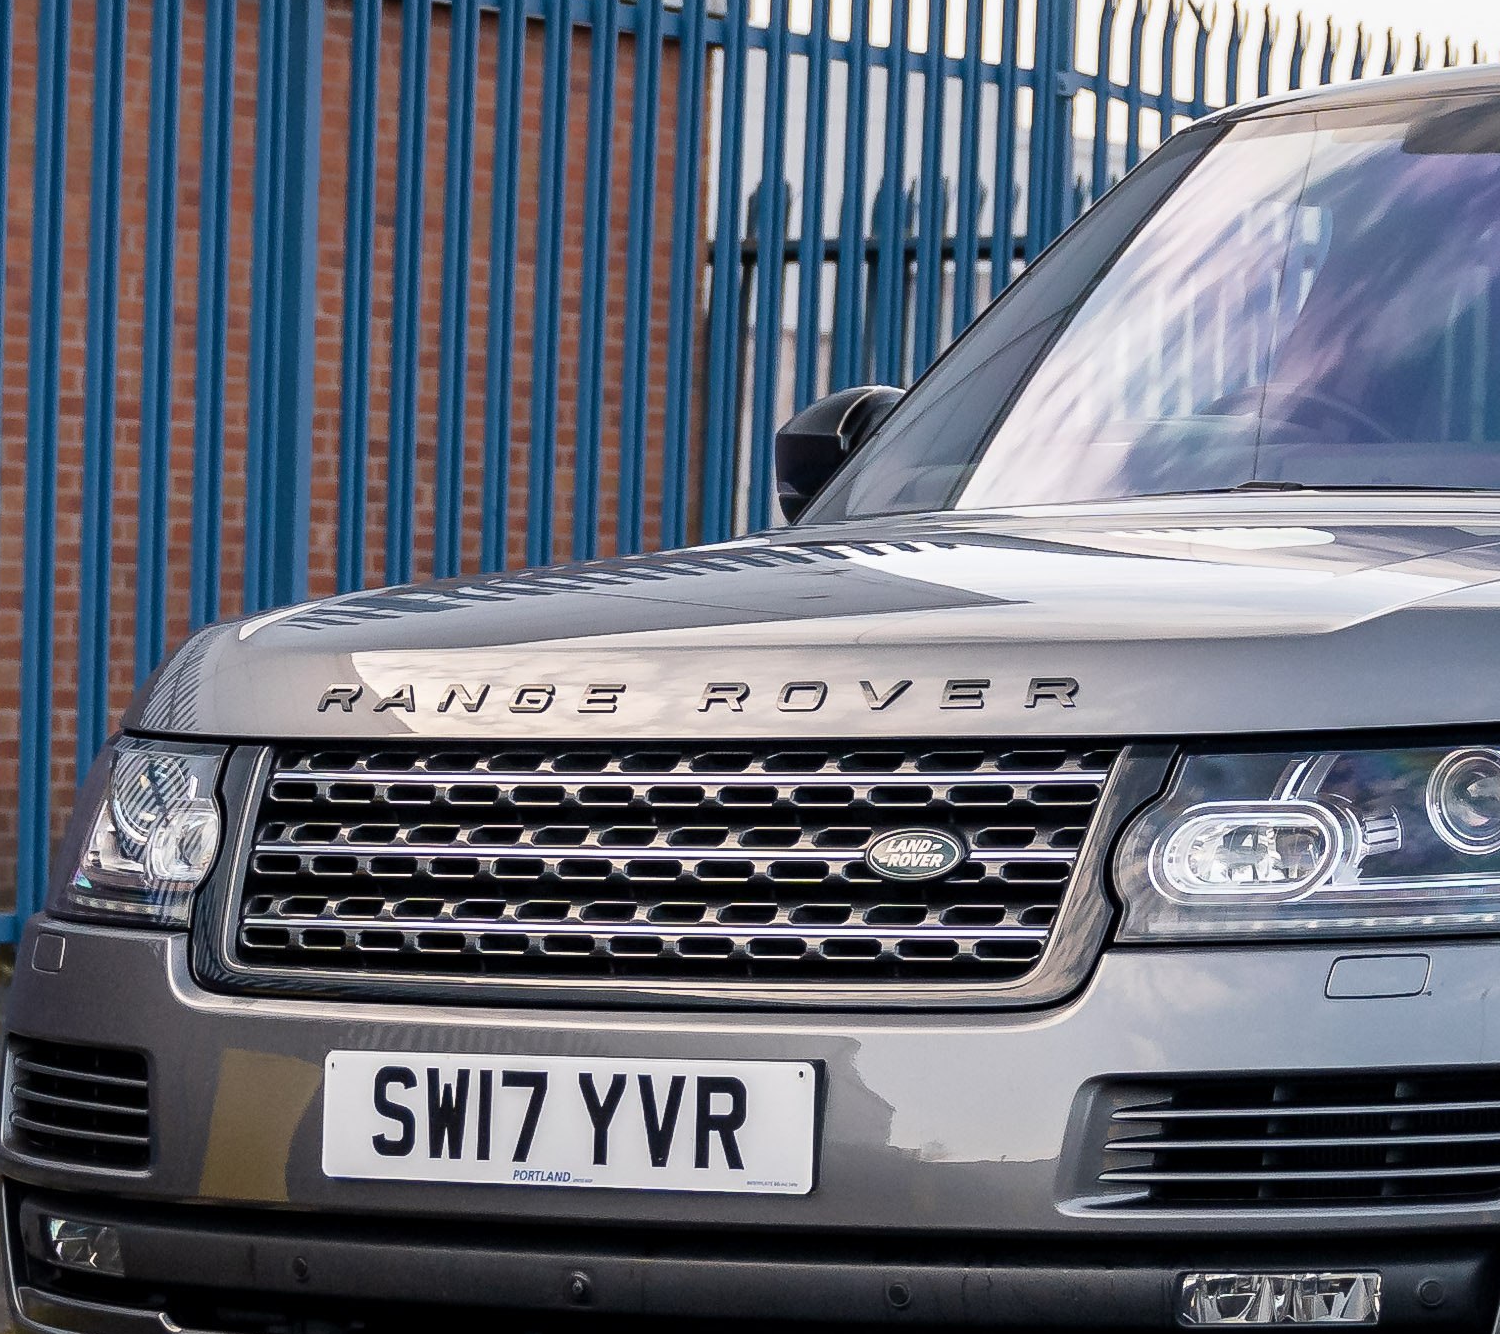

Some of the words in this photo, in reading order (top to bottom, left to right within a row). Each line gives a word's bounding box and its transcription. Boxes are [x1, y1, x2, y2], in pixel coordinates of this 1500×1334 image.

[317, 683, 627, 714] RANGE
[697, 676, 1080, 713] ROVER
[886, 839, 933, 853] LAND
[887, 853, 944, 868] ROVER
[371, 1065, 548, 1163] SW17
[578, 1072, 748, 1170] YVR
[512, 1169, 571, 1182] PORTLAND
